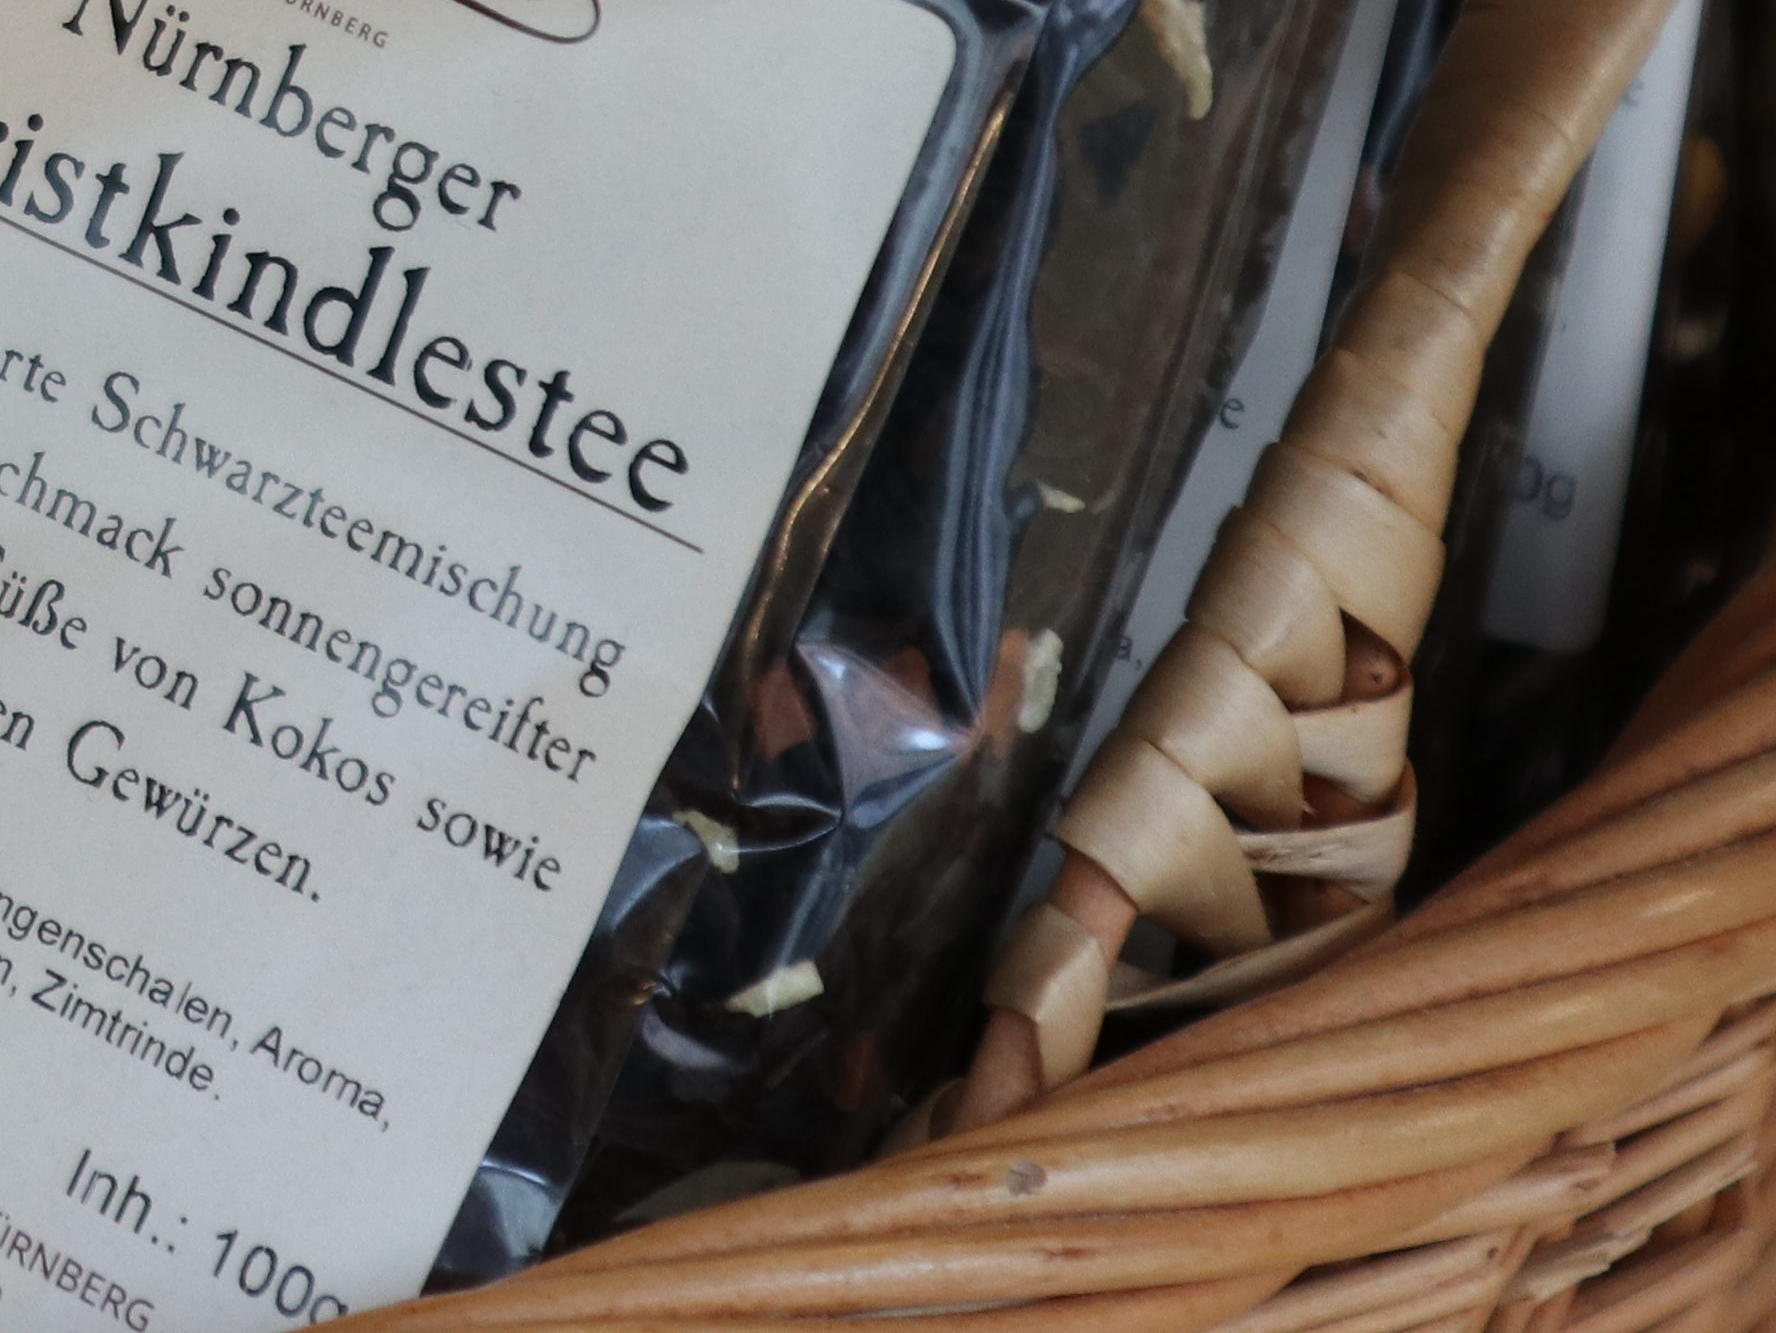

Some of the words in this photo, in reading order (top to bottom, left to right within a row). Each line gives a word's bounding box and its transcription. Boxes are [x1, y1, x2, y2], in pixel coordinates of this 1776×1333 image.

[91, 371, 625, 698] Schwarzteemischung
[113, 635, 200, 711] von
[222, 670, 396, 808] Kokos
[417, 795, 563, 893] sowie
[203, 564, 597, 785] sonnengereifter
[66, 719, 322, 904] Gewürzen.
[31, 968, 221, 1102] Zimtrinde.
[249, 1026, 393, 1132] Aroma,
[65, 1148, 189, 1254] Inh.:
